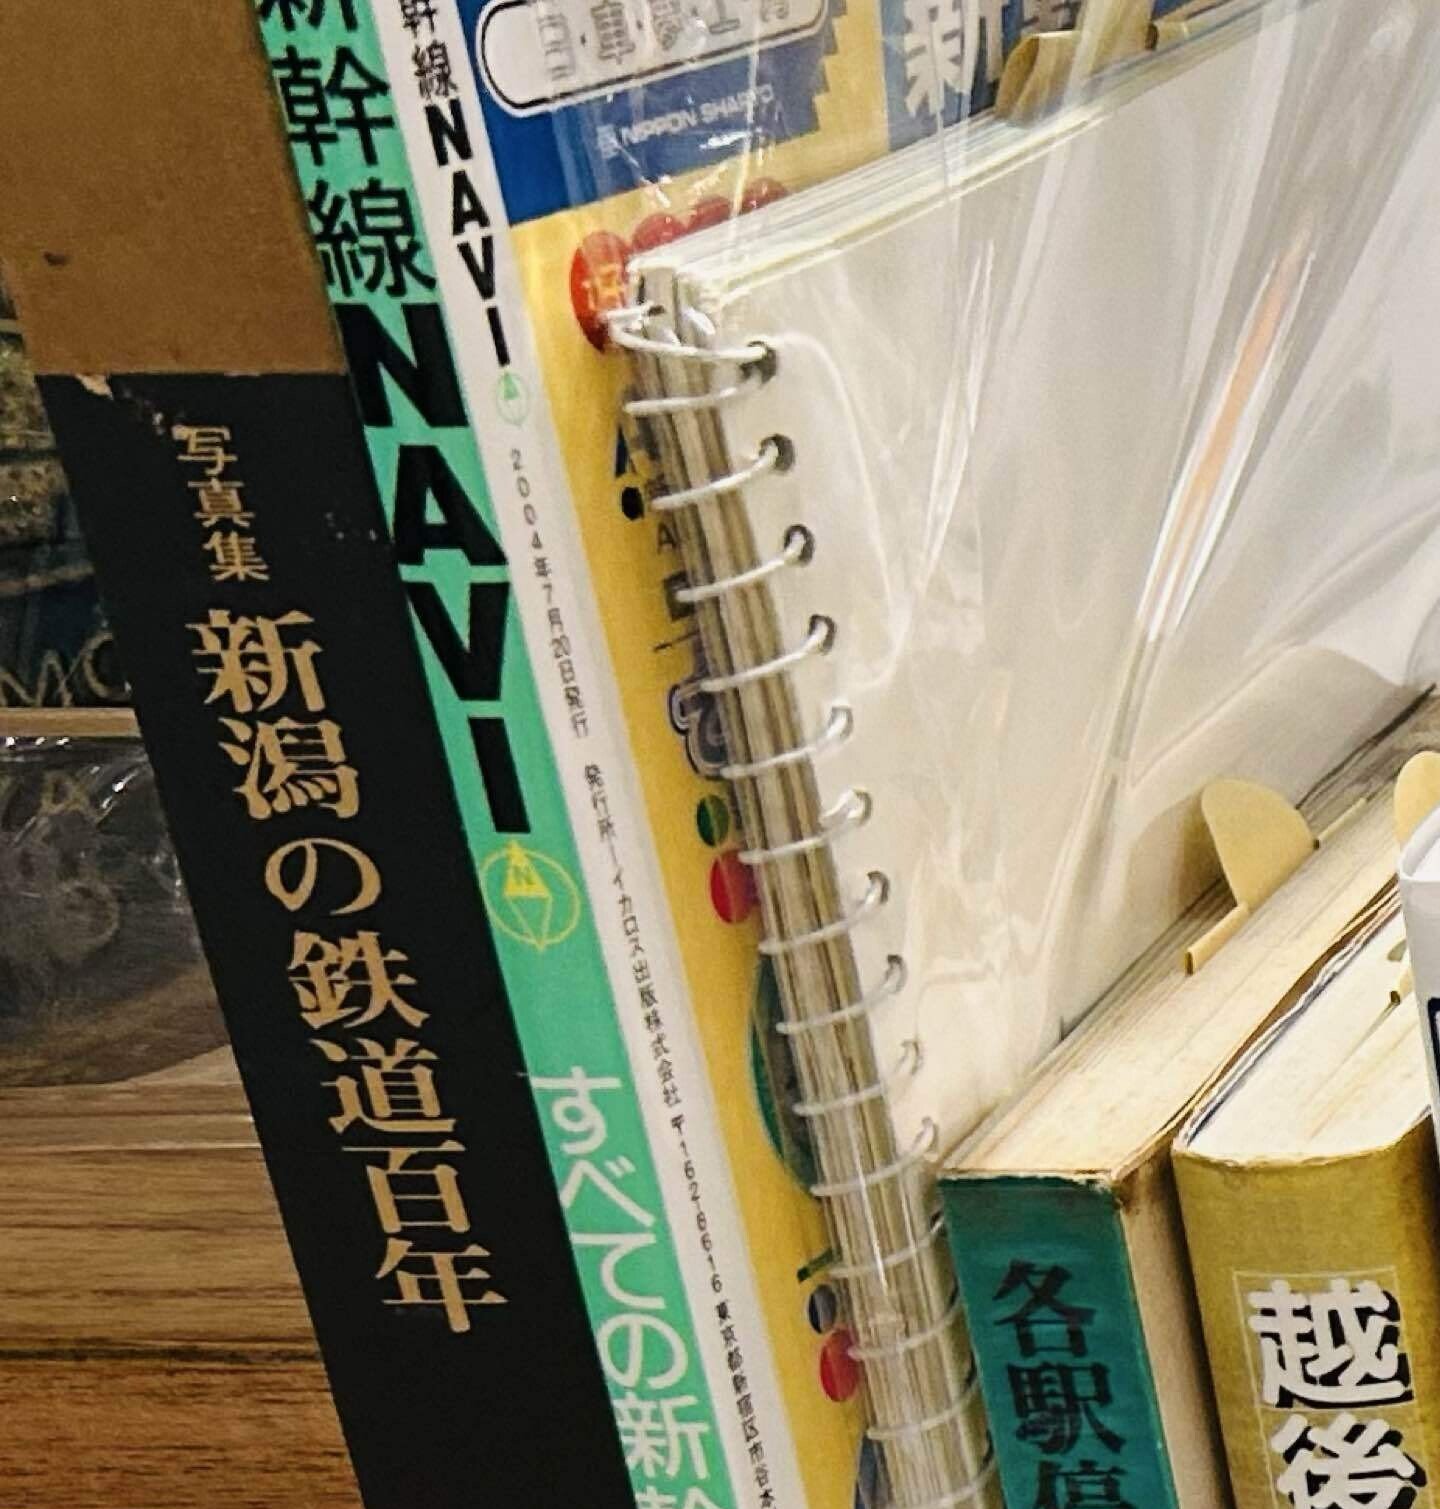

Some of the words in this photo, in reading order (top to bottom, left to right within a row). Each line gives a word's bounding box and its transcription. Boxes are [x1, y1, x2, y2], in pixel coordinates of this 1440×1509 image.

[170, 423, 270, 583] 写真集
[182, 609, 509, 1334] 新潟の鉄道百年
